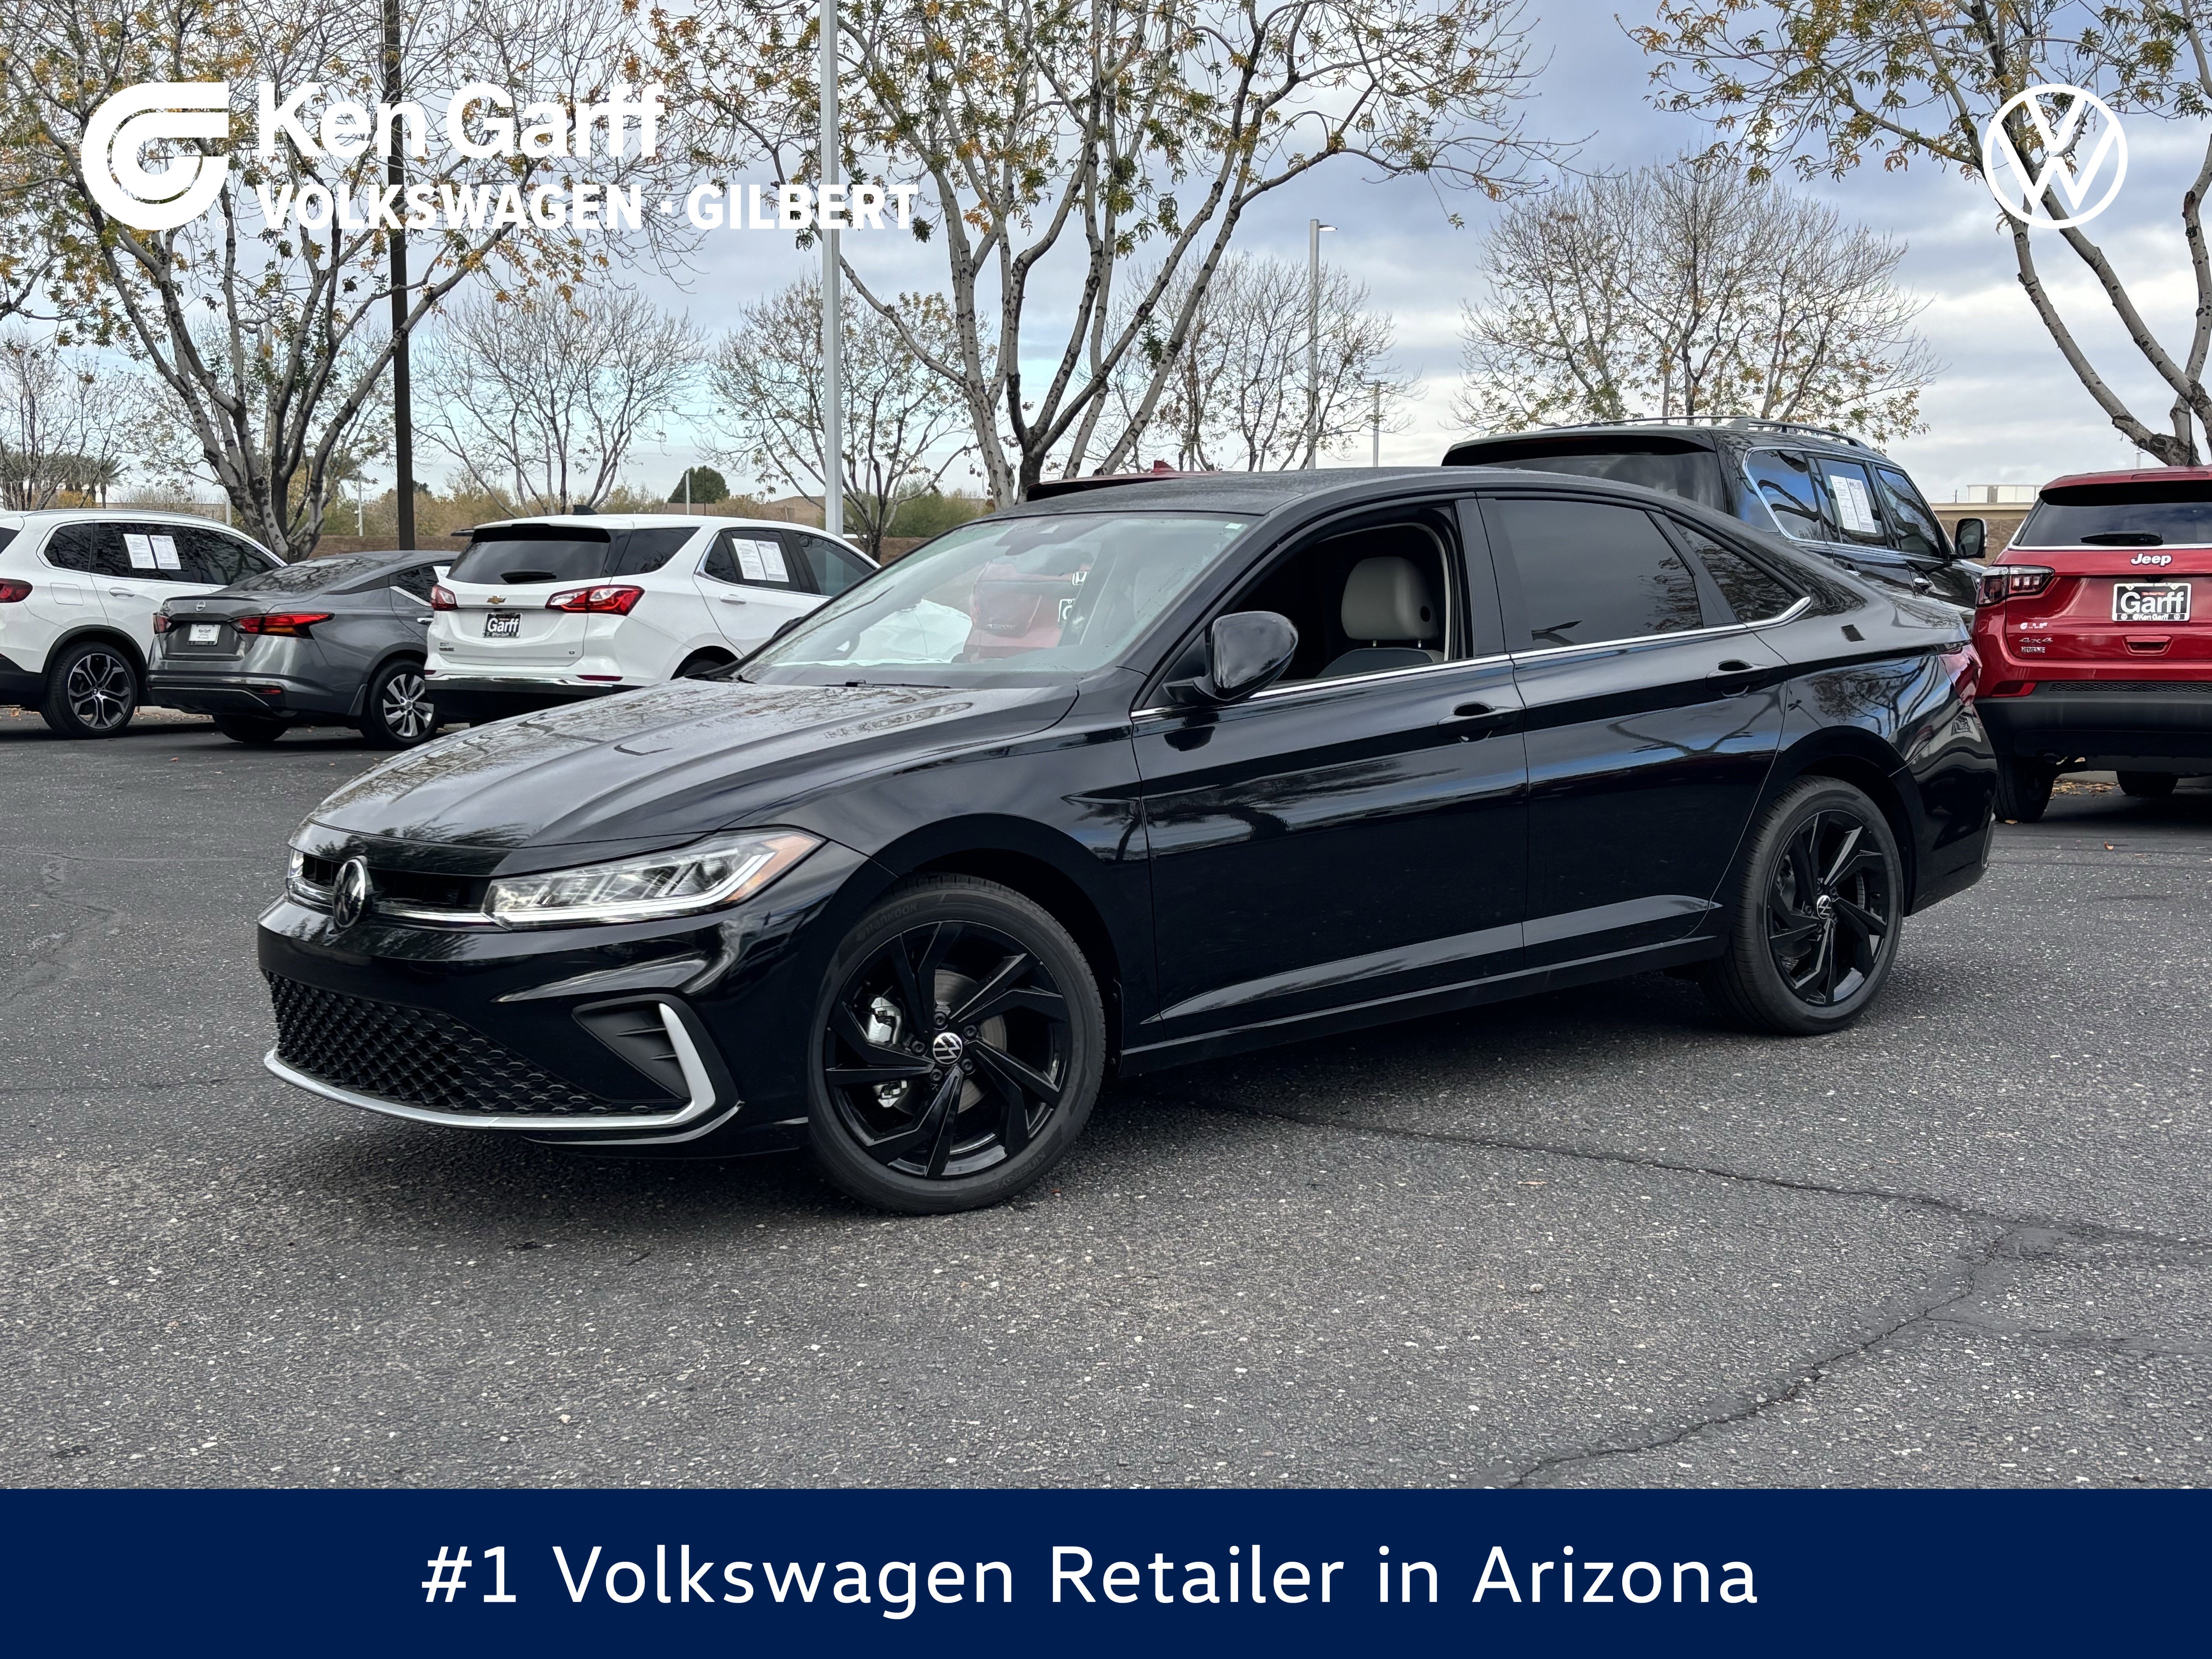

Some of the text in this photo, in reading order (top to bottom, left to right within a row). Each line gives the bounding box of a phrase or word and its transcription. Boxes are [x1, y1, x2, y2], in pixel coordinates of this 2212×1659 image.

[2131, 553, 2172, 566] Jeep
[2121, 591, 2184, 613] Garff
[488, 618, 519, 632] Garff
